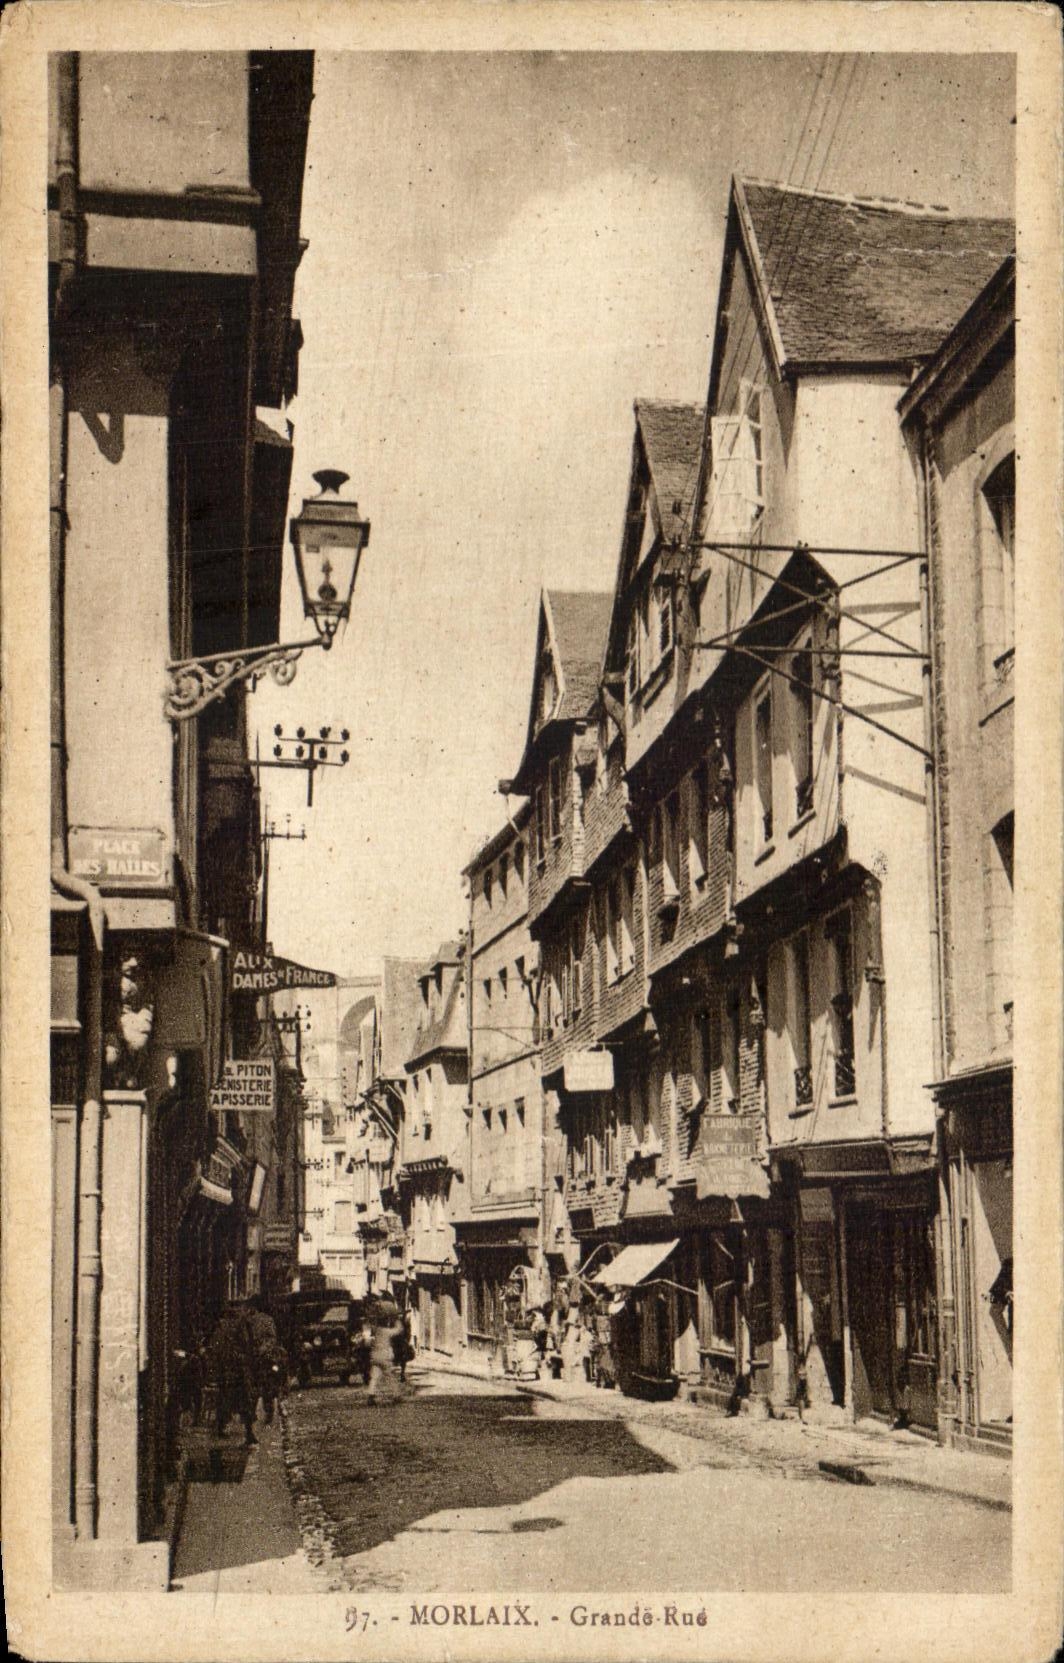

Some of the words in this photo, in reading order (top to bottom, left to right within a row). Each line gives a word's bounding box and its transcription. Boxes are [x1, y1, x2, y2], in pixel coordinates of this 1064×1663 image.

[92, 839, 140, 855] PLACE
[106, 859, 161, 876] HALLES
[233, 952, 272, 969] AUX
[233, 973, 278, 989] DAMES
[286, 966, 331, 985] FRANCE
[237, 1065, 271, 1076] PITON
